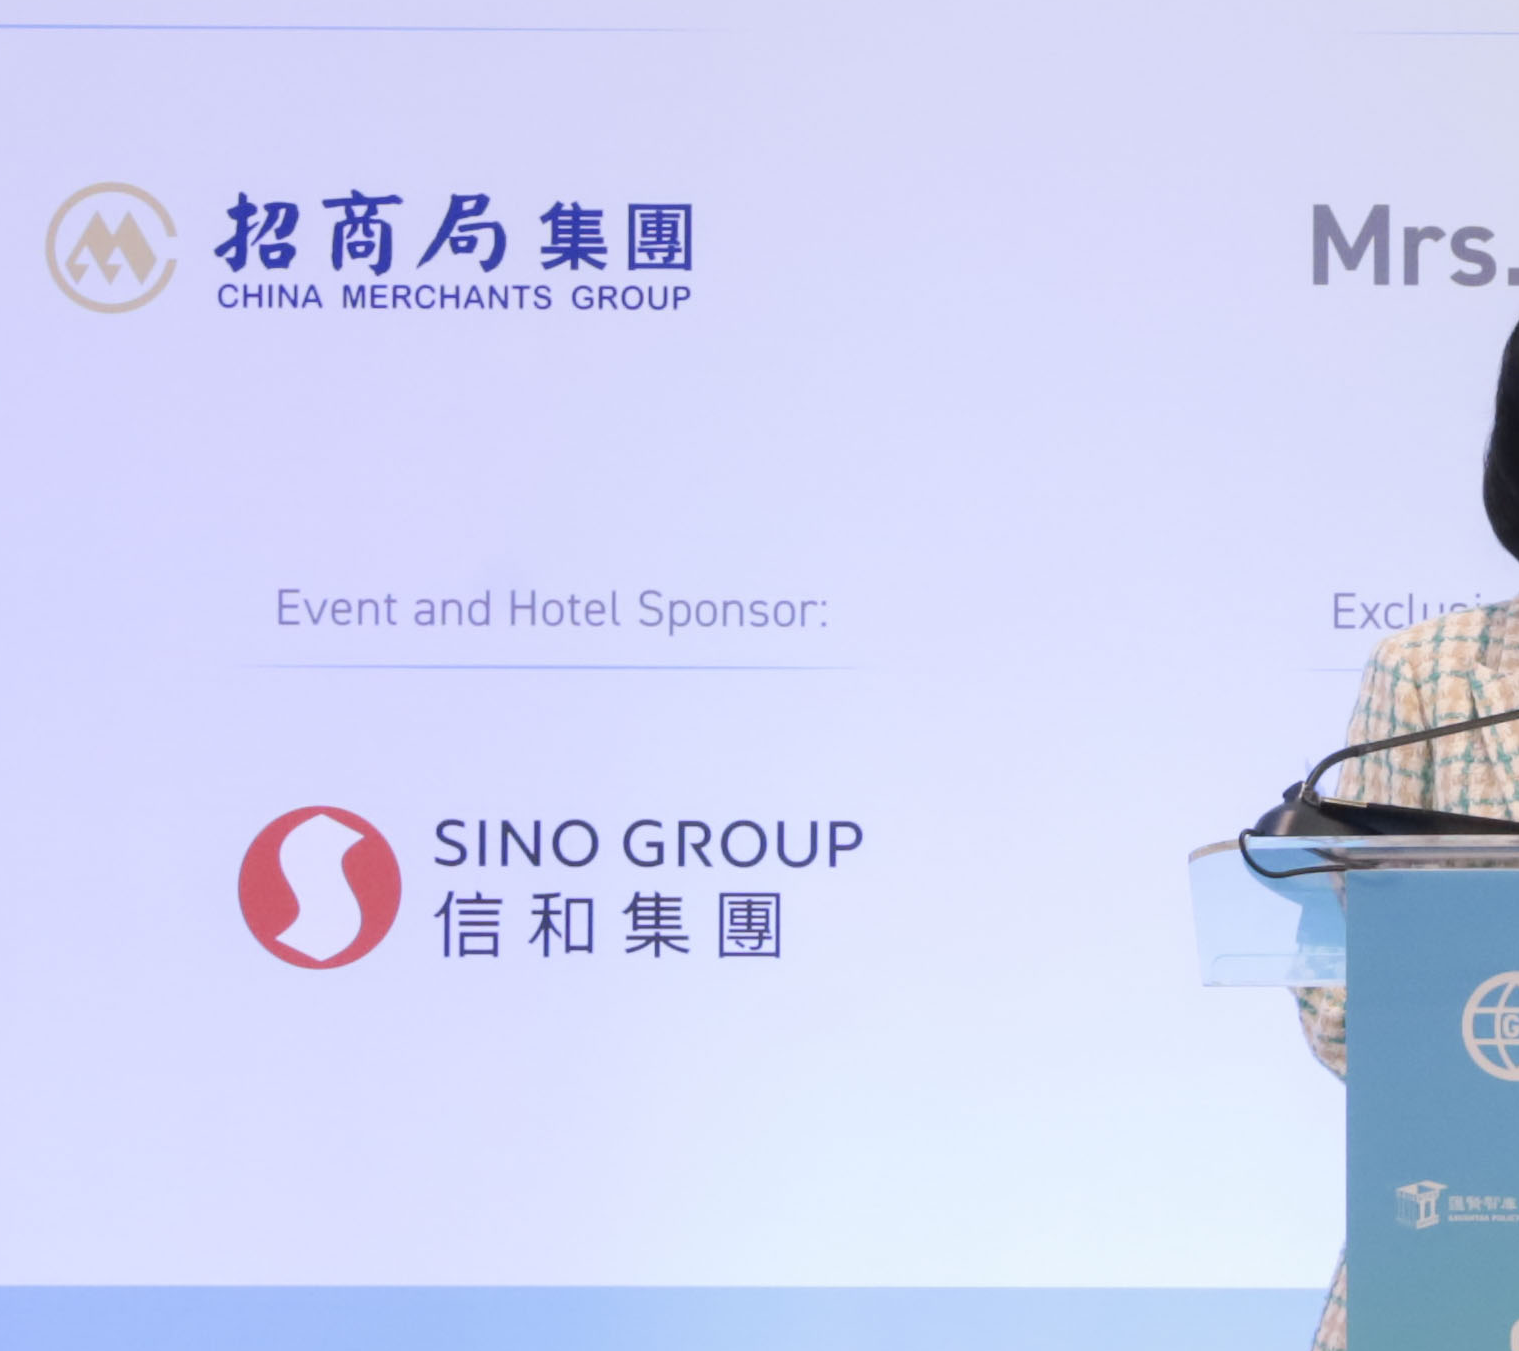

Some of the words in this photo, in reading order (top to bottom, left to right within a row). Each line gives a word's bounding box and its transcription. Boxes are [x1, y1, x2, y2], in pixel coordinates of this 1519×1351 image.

[214, 189, 692, 276] 招商局集團
[218, 284, 323, 308] CHINA
[343, 284, 552, 310] MERCHANTS
[572, 285, 691, 310] GROUP
[278, 589, 397, 626] Event
[414, 590, 490, 626] and
[510, 590, 620, 627] Hotel
[639, 590, 826, 636] Sponsor:
[435, 819, 599, 867] SINO
[623, 819, 863, 868] GROUP
[434, 891, 780, 958] 信和集團
